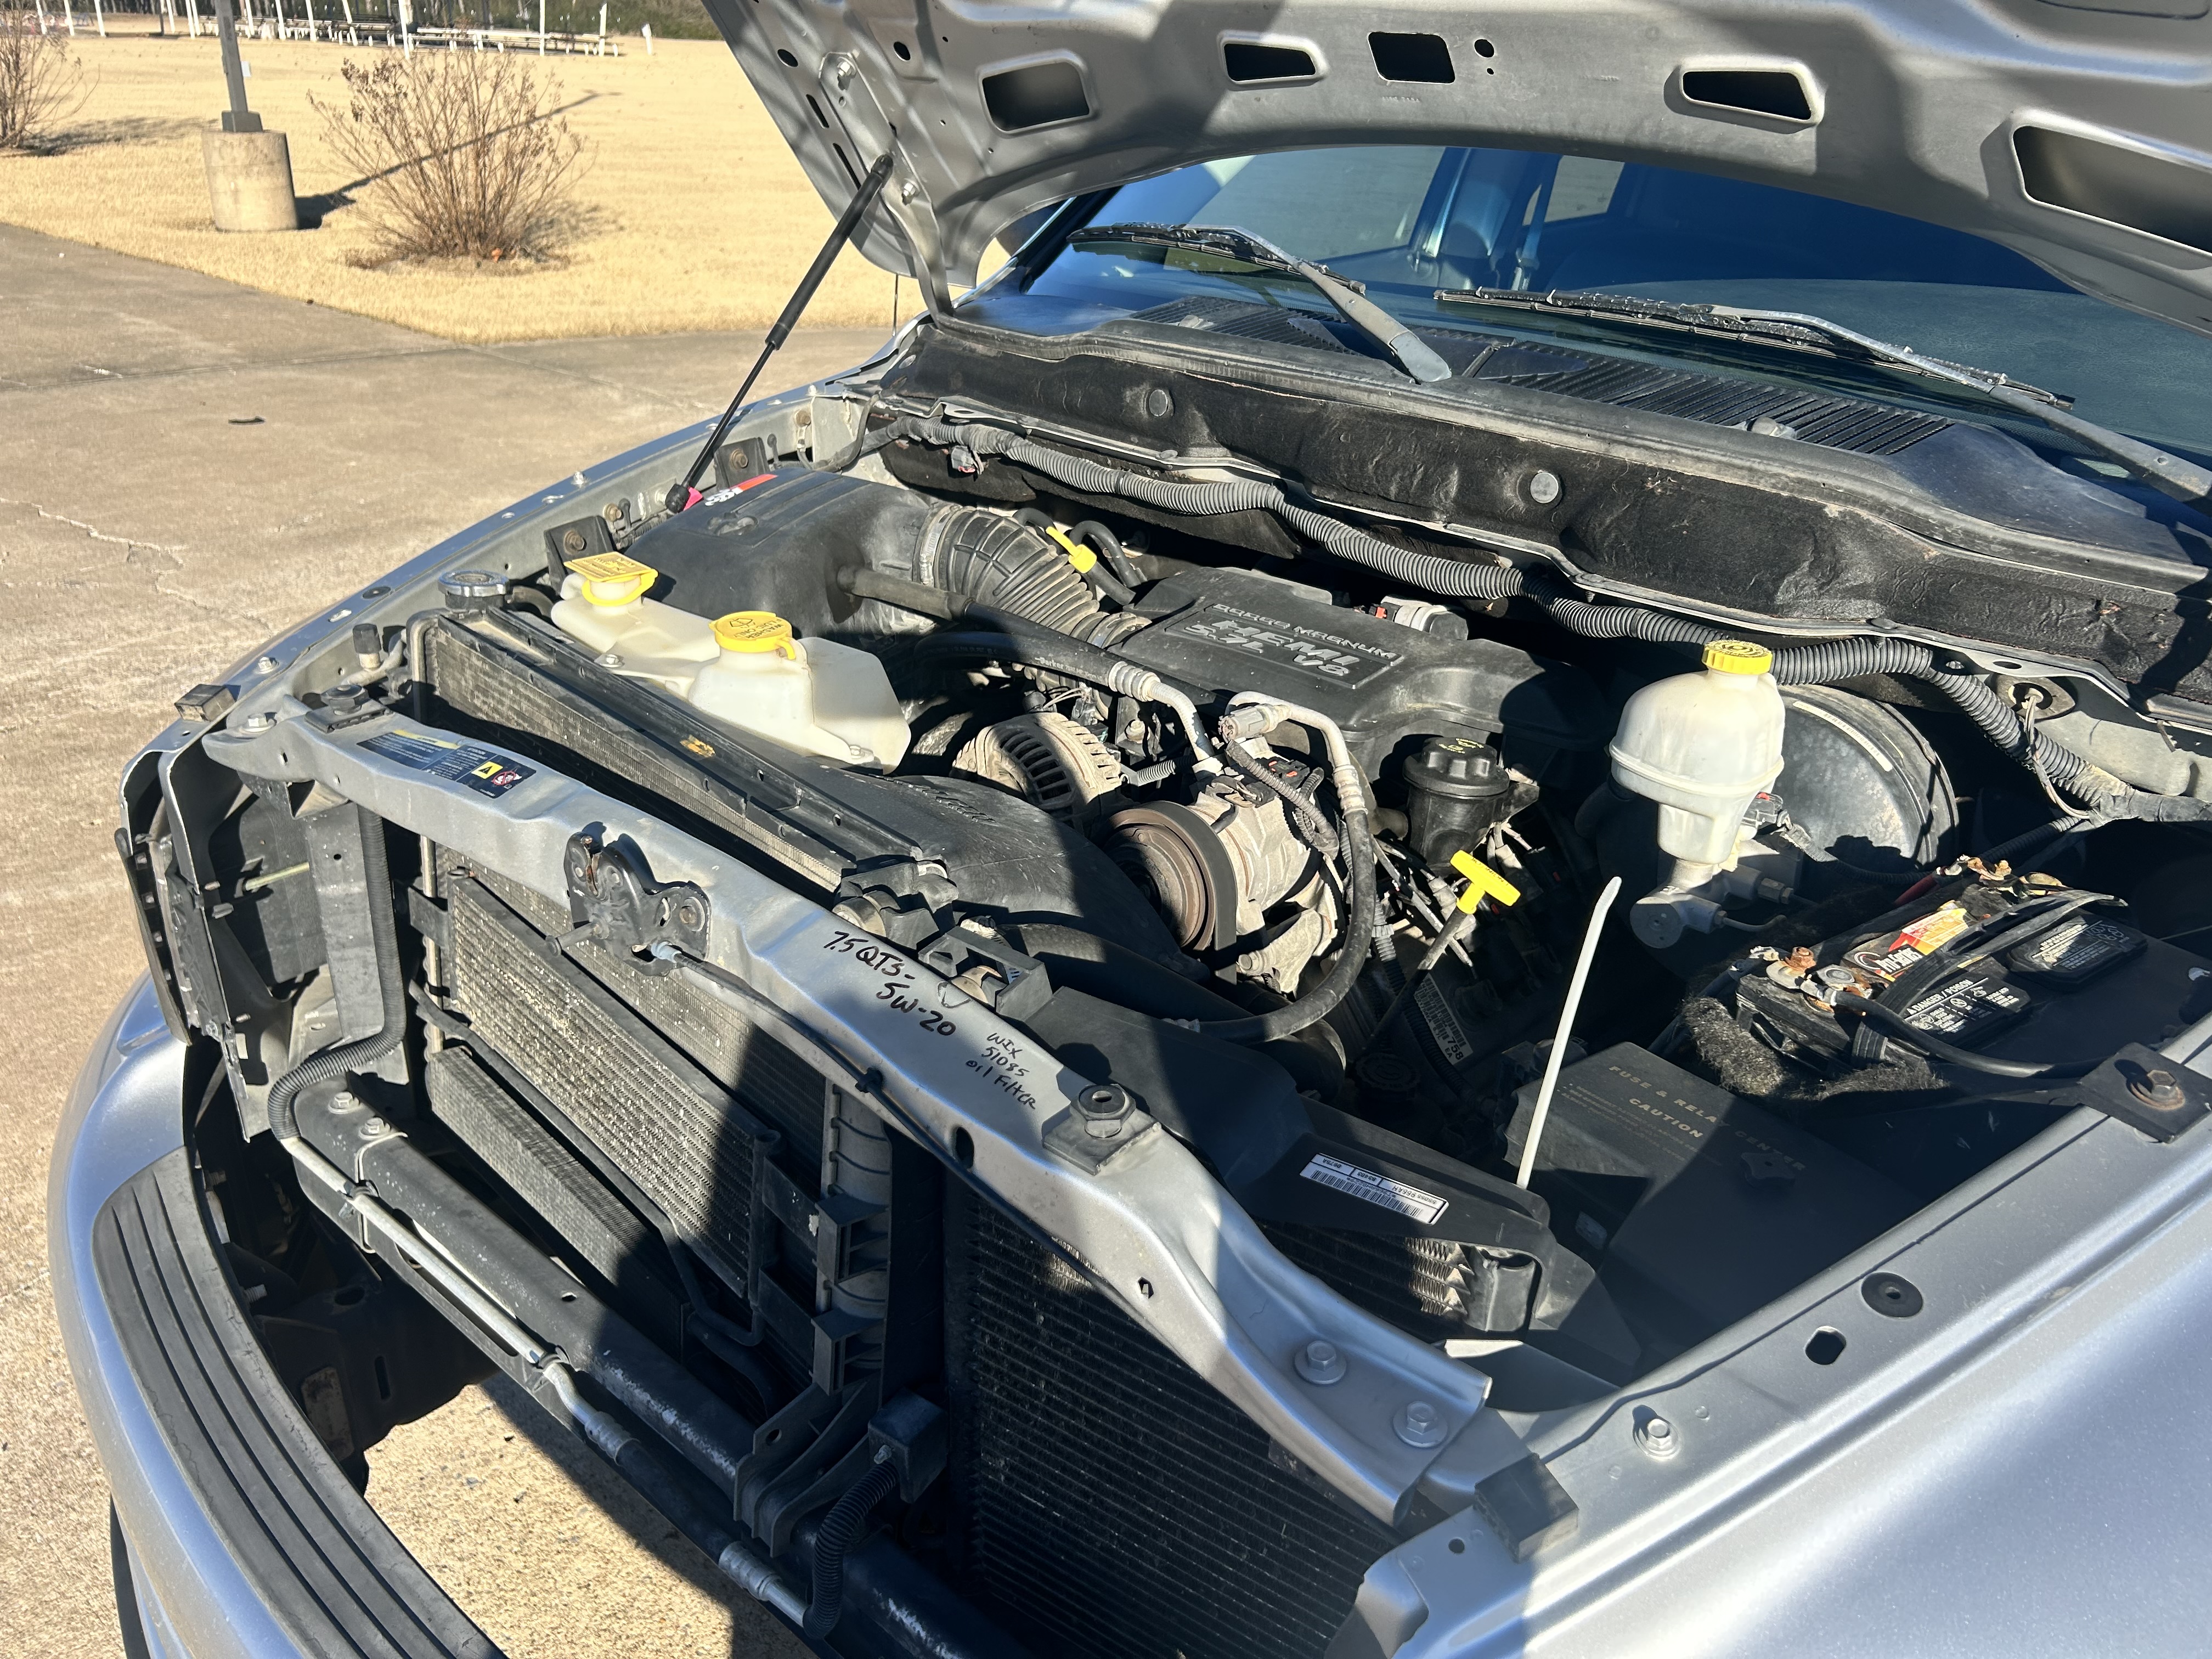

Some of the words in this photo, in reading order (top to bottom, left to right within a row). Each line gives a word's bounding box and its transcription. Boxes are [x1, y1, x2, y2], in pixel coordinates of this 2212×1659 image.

[1211, 620, 1360, 665] HEMI
[1212, 603, 1290, 629] DODGE
[1293, 625, 1397, 659] MAGNUM
[1184, 624, 1263, 653] 5.7L
[1293, 654, 1350, 676] V8
[1911, 994, 1944, 1012] DANGER
[1944, 979, 1974, 995] POISON
[981, 1046, 1030, 1077] 51085
[987, 1032, 1023, 1059] WIX
[1444, 1047, 1453, 1058] EA
[1447, 1036, 1464, 1060] 758
[1608, 1065, 1652, 1090] FUSE
[1655, 1090, 1668, 1098] &
[1673, 1098, 1731, 1127] RELAY
[1628, 1098, 1703, 1138] CAUTION
